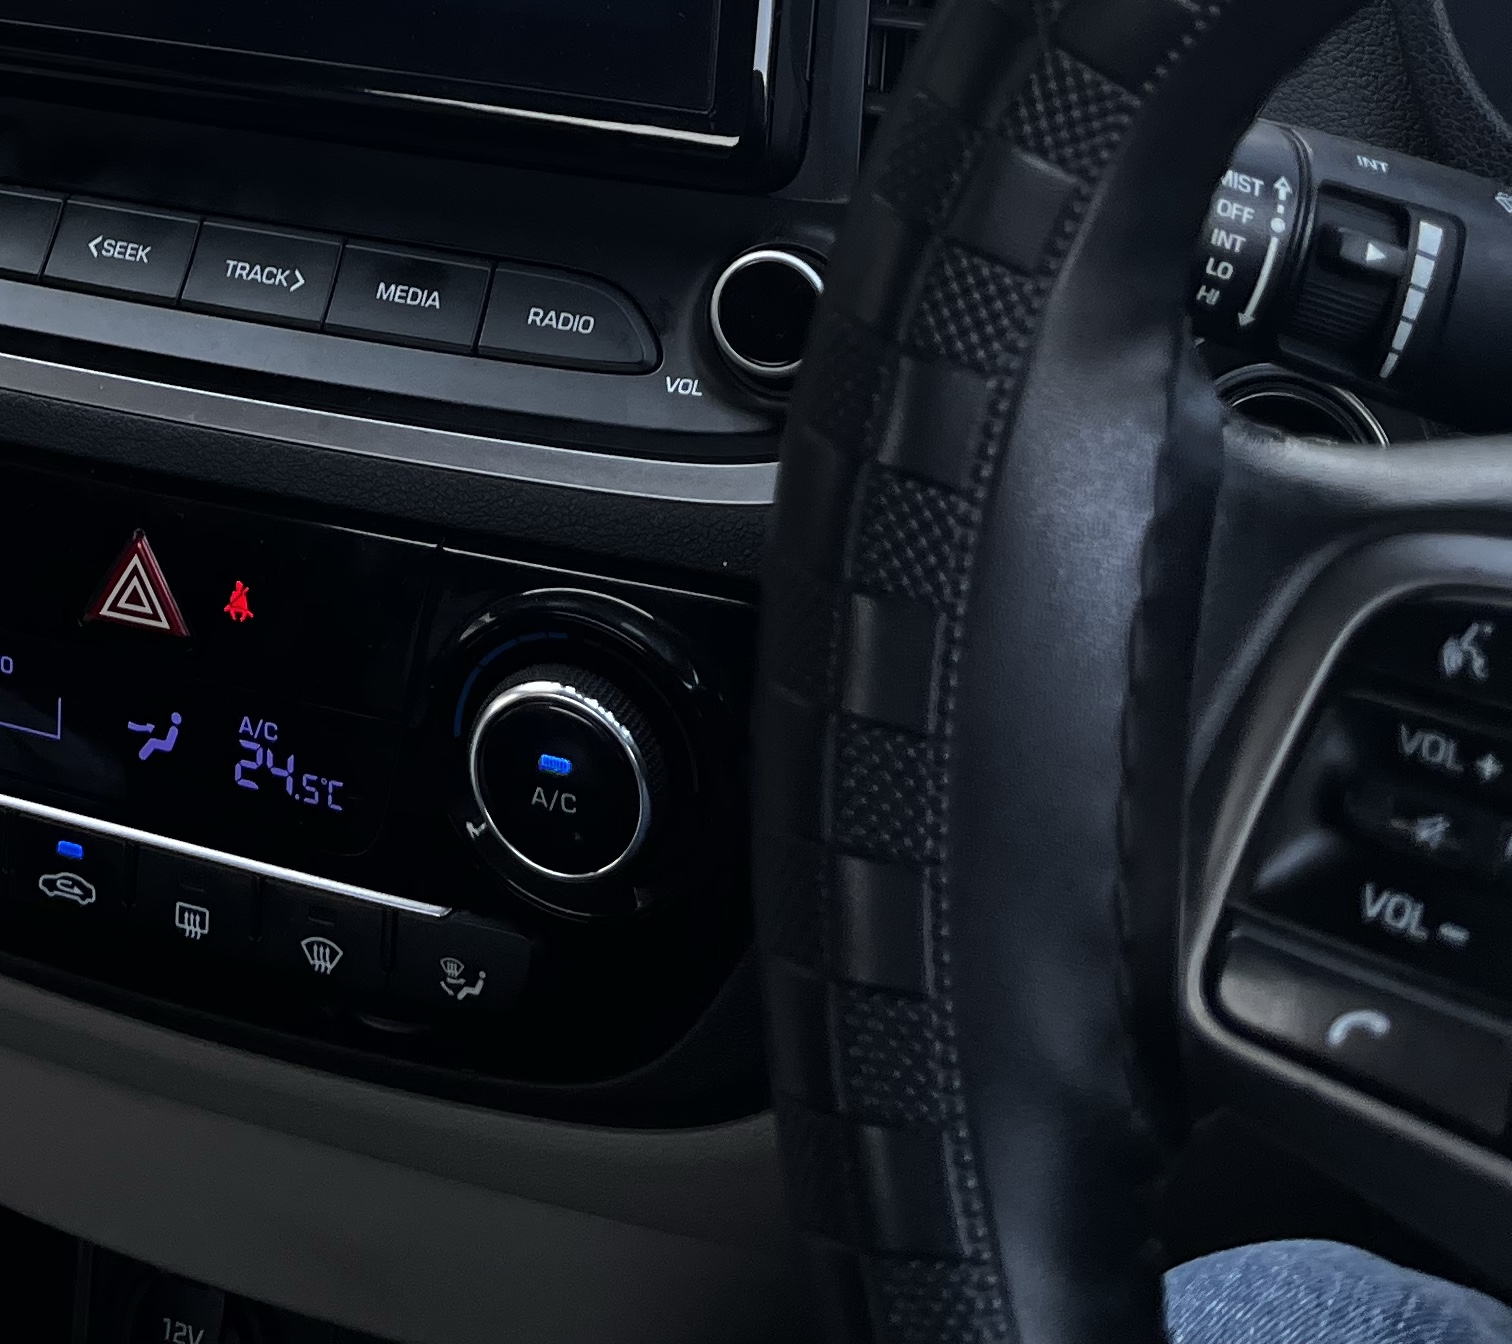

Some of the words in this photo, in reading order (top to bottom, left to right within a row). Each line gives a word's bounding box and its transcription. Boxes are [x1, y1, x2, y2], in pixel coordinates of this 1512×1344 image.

[1356, 154, 1389, 173] INT
[1216, 198, 1256, 224] OFF
[101, 239, 151, 264] SEEK
[1211, 228, 1247, 253] INT
[225, 258, 290, 288] TRACK
[1205, 257, 1234, 281] LO
[376, 282, 441, 311] MEDIA
[1196, 284, 1220, 306] HI
[527, 307, 595, 335] RADIO
[664, 375, 703, 397] VOL
[238, 715, 279, 742] A/C
[530, 786, 579, 815] A/C
[163, 1316, 205, 1344] 12V
